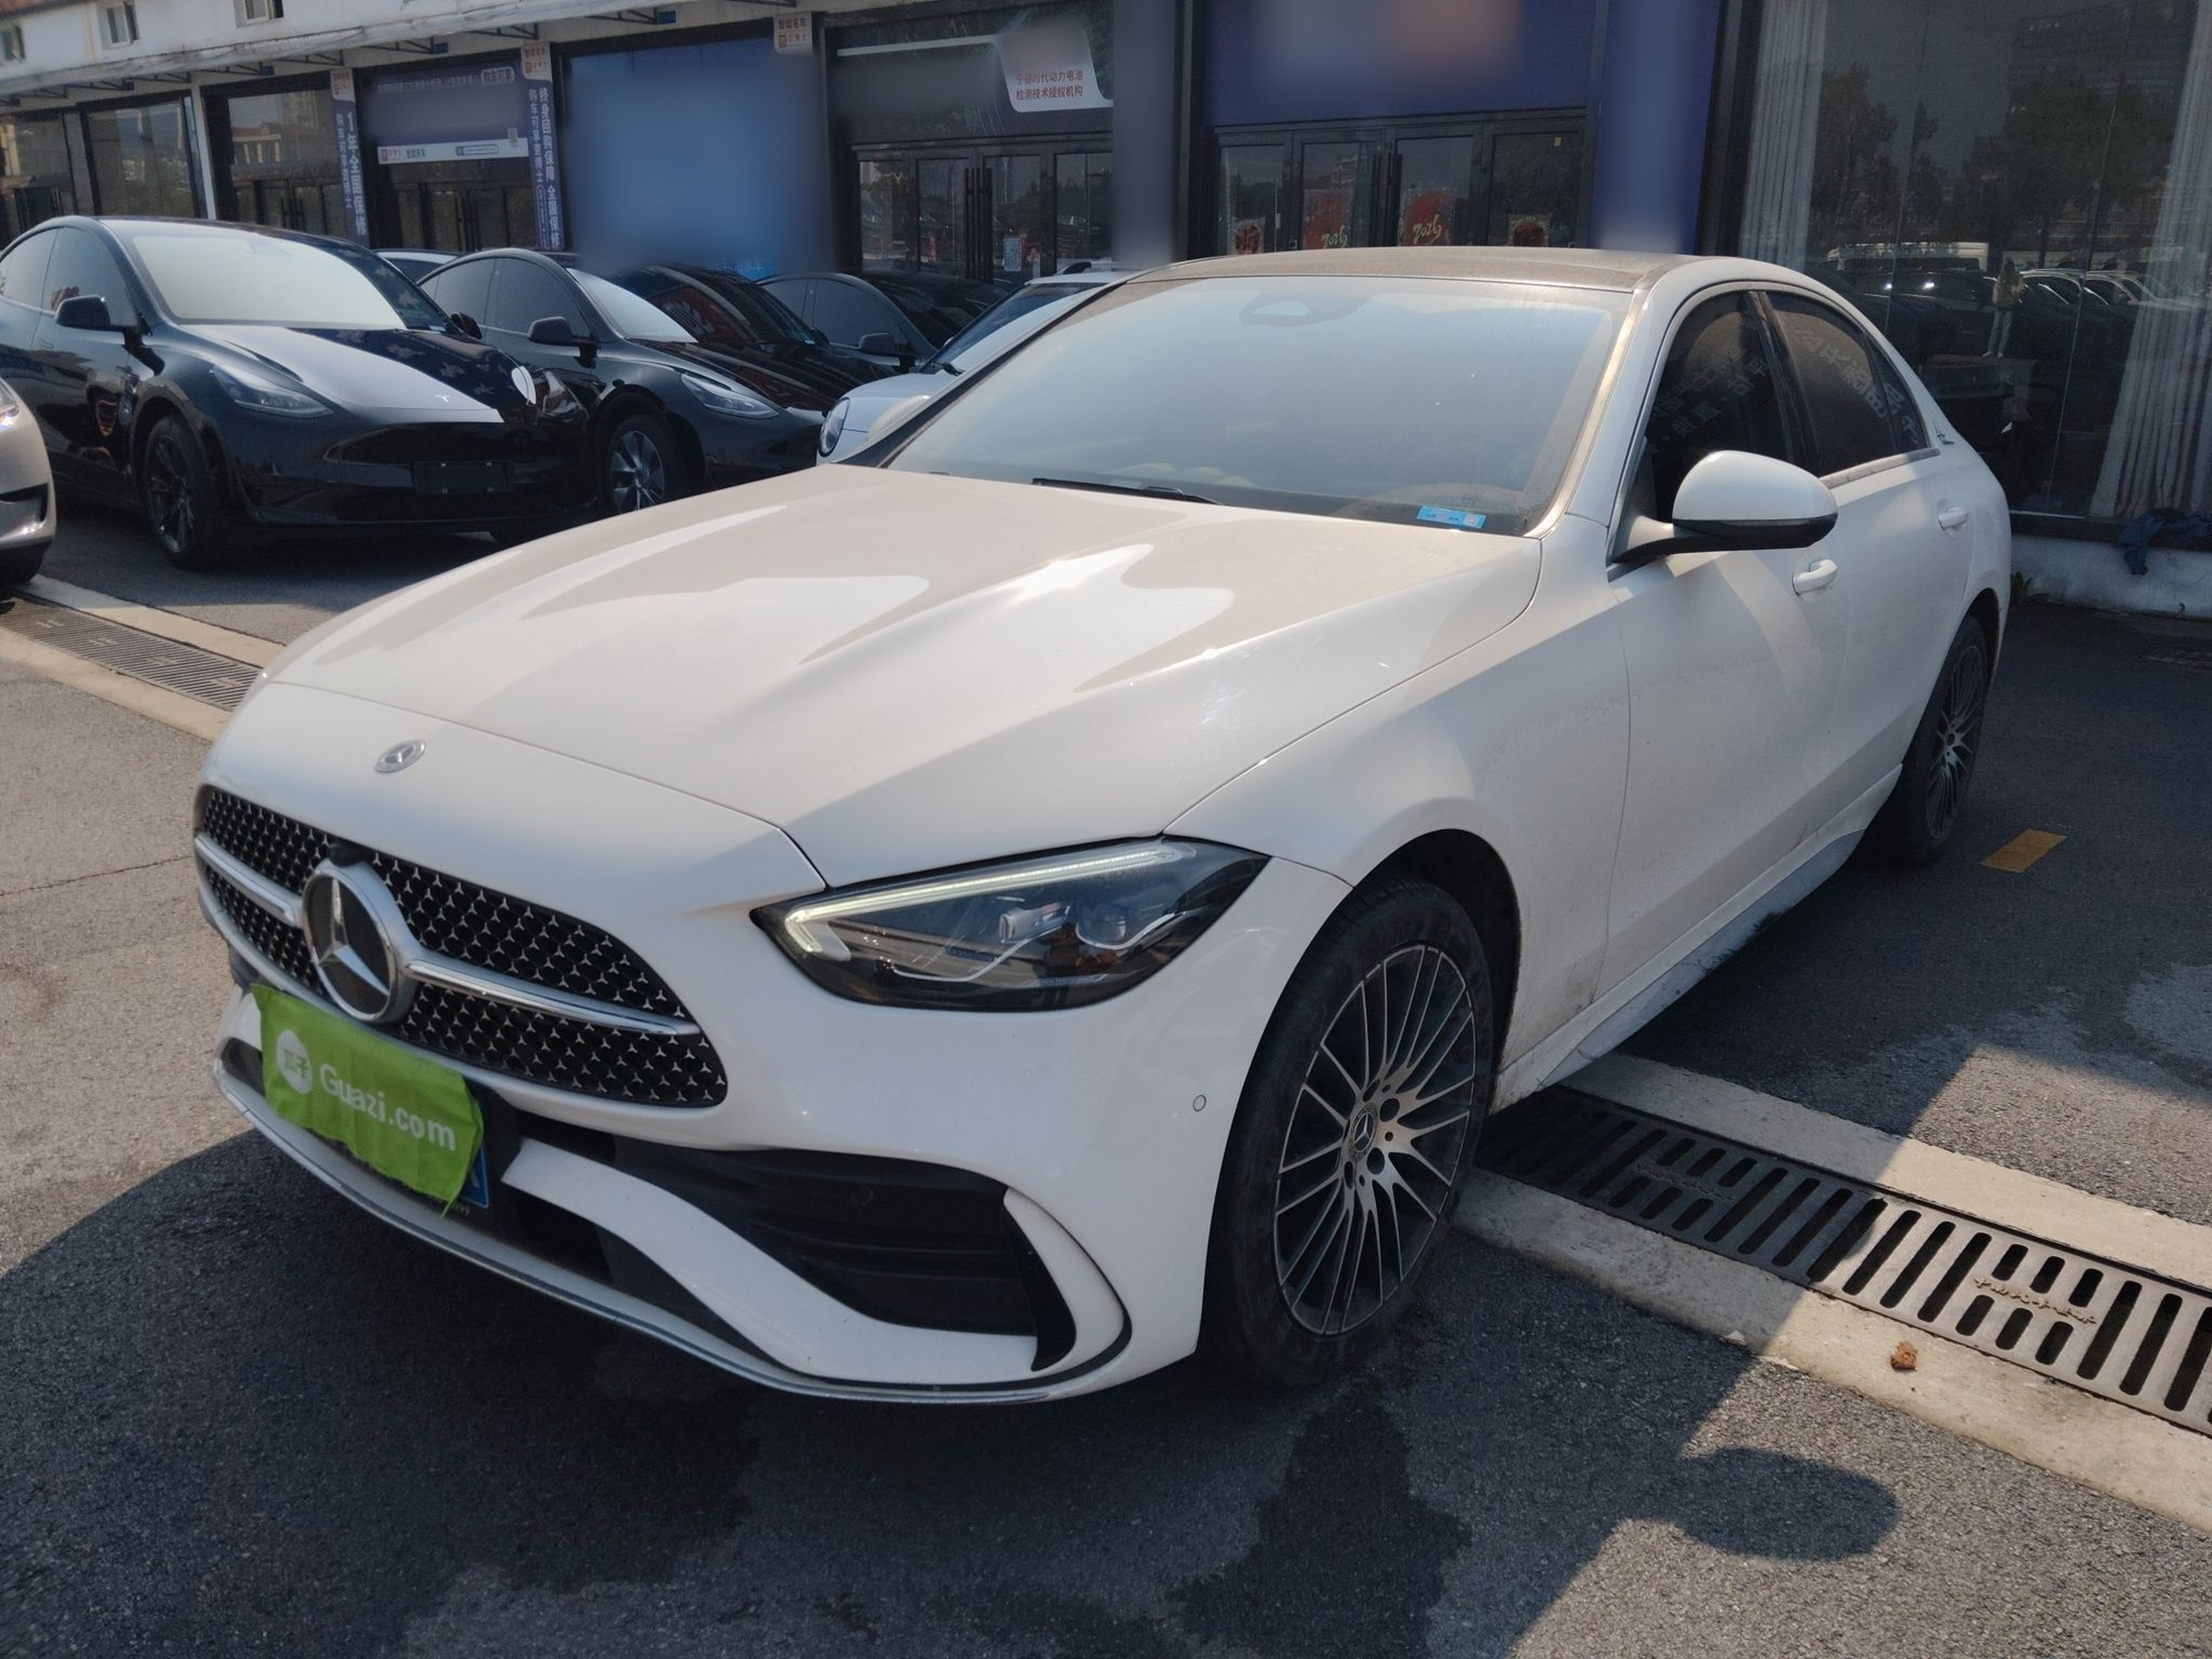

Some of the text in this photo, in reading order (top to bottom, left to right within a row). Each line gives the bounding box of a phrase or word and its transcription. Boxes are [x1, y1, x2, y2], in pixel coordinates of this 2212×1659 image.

[1016, 69, 1084, 85] 宁德时代动力电池
[1016, 85, 1084, 100] 检测技术授权机构
[319, 1063, 456, 1152] Guazi.com
